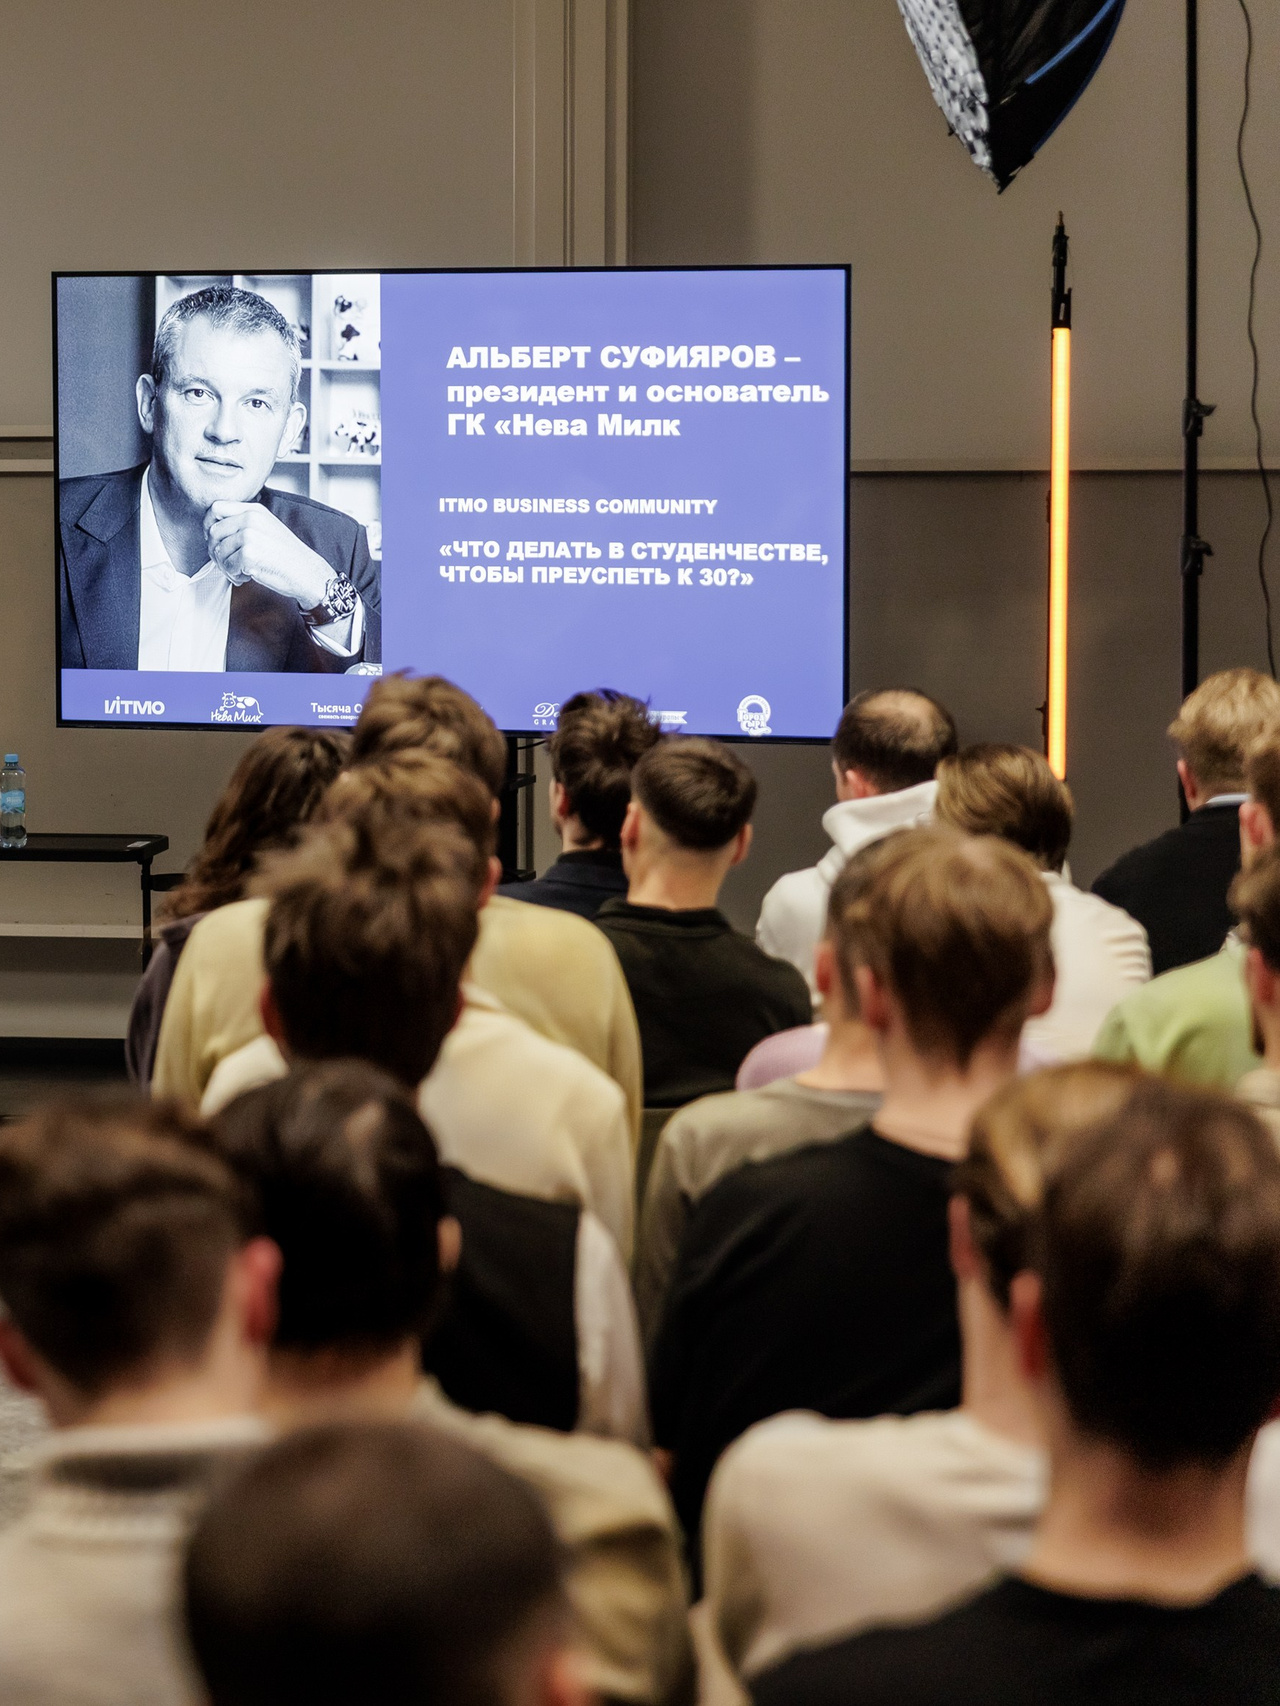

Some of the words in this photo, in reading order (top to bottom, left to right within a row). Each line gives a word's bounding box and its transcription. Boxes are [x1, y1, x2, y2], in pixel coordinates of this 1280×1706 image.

[446, 345, 592, 369] АЛЬБЕРТ
[600, 344, 777, 369] СУФИЯРОВ
[447, 385, 610, 407] президент
[618, 385, 637, 403] и
[646, 384, 830, 403] основатель
[448, 413, 486, 436] ГК
[494, 413, 588, 437] «Нева
[597, 413, 681, 437] Милк
[439, 497, 488, 513] ITMO
[493, 498, 591, 514] BUSINESS
[595, 498, 718, 515] COMMUNITY
[439, 540, 501, 559] «ЧТО
[505, 541, 602, 561] ДЕЛАТЬ
[608, 542, 625, 560] В
[631, 541, 829, 566] СТУДЕНЧЕСТВЕ,
[439, 565, 524, 584] ЧТОБЫ
[531, 566, 671, 585] ПРЕУСПЕТЬ
[677, 567, 694, 586] К
[699, 567, 754, 587] 30?»
[210, 708, 233, 722] Нева
[234, 709, 262, 723] Милк
[310, 702, 352, 713] Тысяча
[533, 718, 555, 726] GRA
